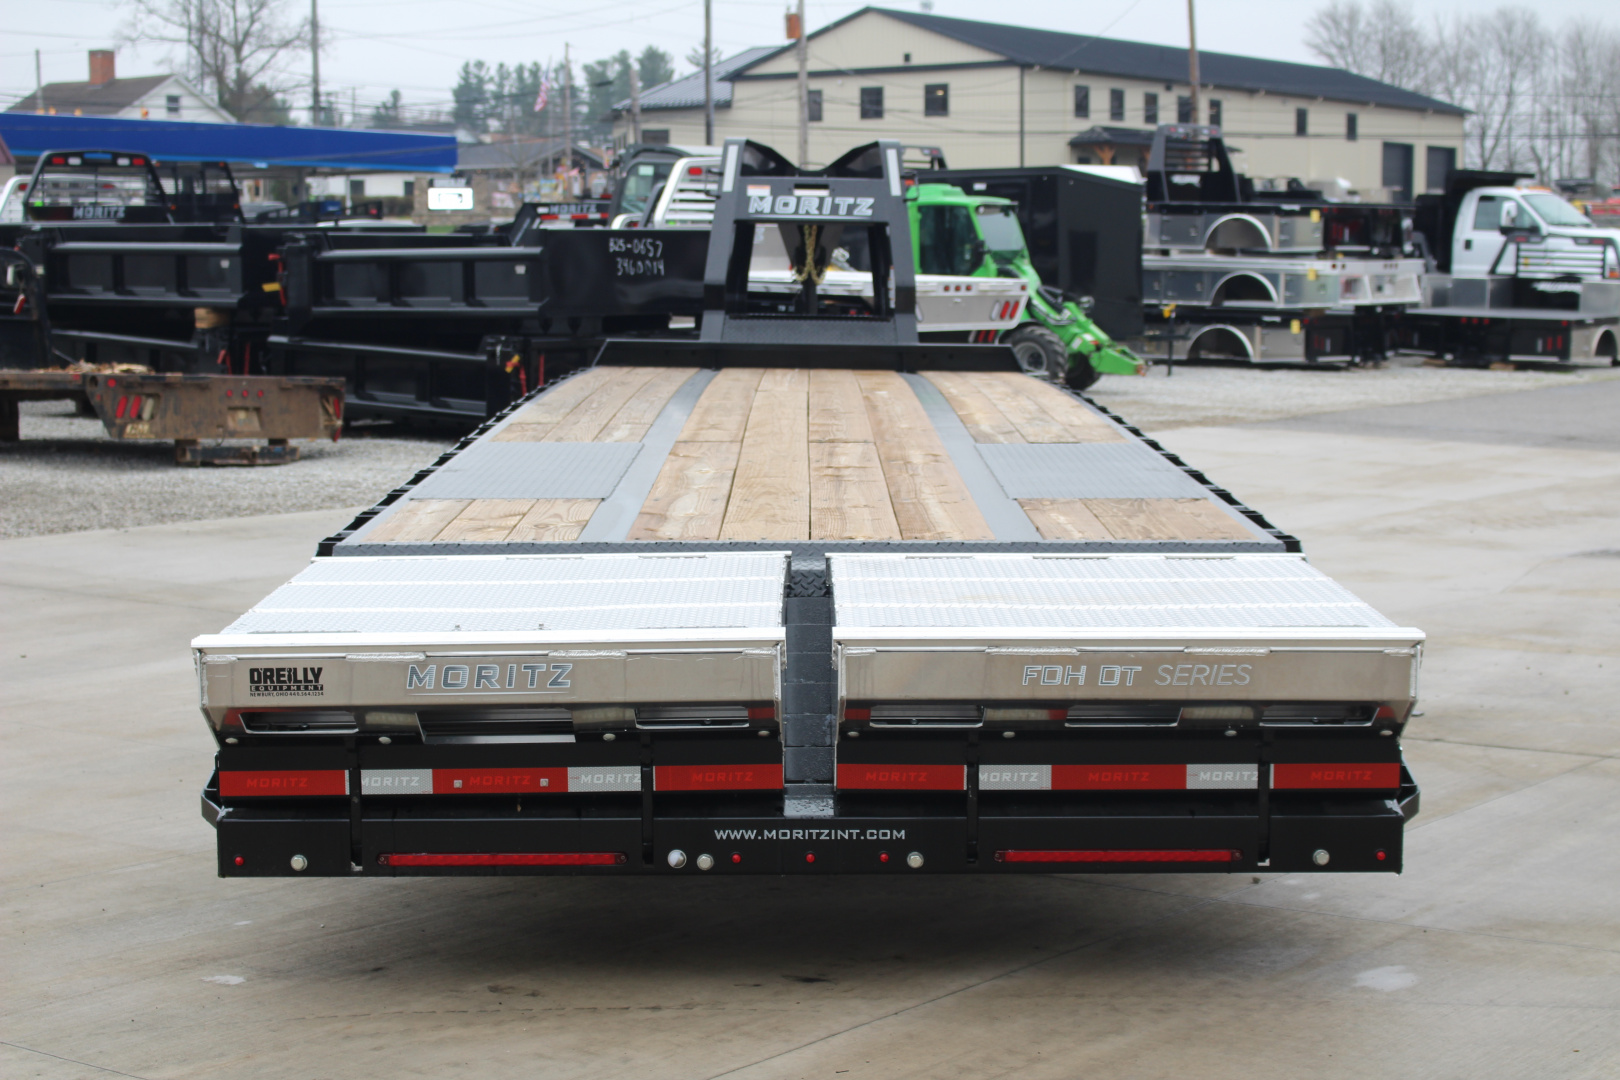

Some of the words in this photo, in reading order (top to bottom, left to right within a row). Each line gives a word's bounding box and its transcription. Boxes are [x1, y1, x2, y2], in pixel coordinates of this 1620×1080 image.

[549, 204, 597, 214] MORITZ
[747, 195, 875, 216] MORITZ
[73, 206, 126, 219] MORITZ
[406, 664, 573, 689] MORITZ
[1154, 664, 1252, 686] SERIES
[469, 775, 531, 785] MORITZ
[580, 774, 641, 784] MORITZ
[692, 772, 753, 782] MORITZ
[865, 771, 928, 782] MORITZ
[979, 772, 1039, 782] MORITZ
[1088, 772, 1150, 782] MORITZ
[1199, 772, 1258, 781] MORITZ
[1310, 770, 1373, 781] MORITZ
[246, 778, 309, 788] MORITZ
[361, 777, 420, 787] MORITZ
[714, 829, 906, 840] WWW.MORITZINT.COM
